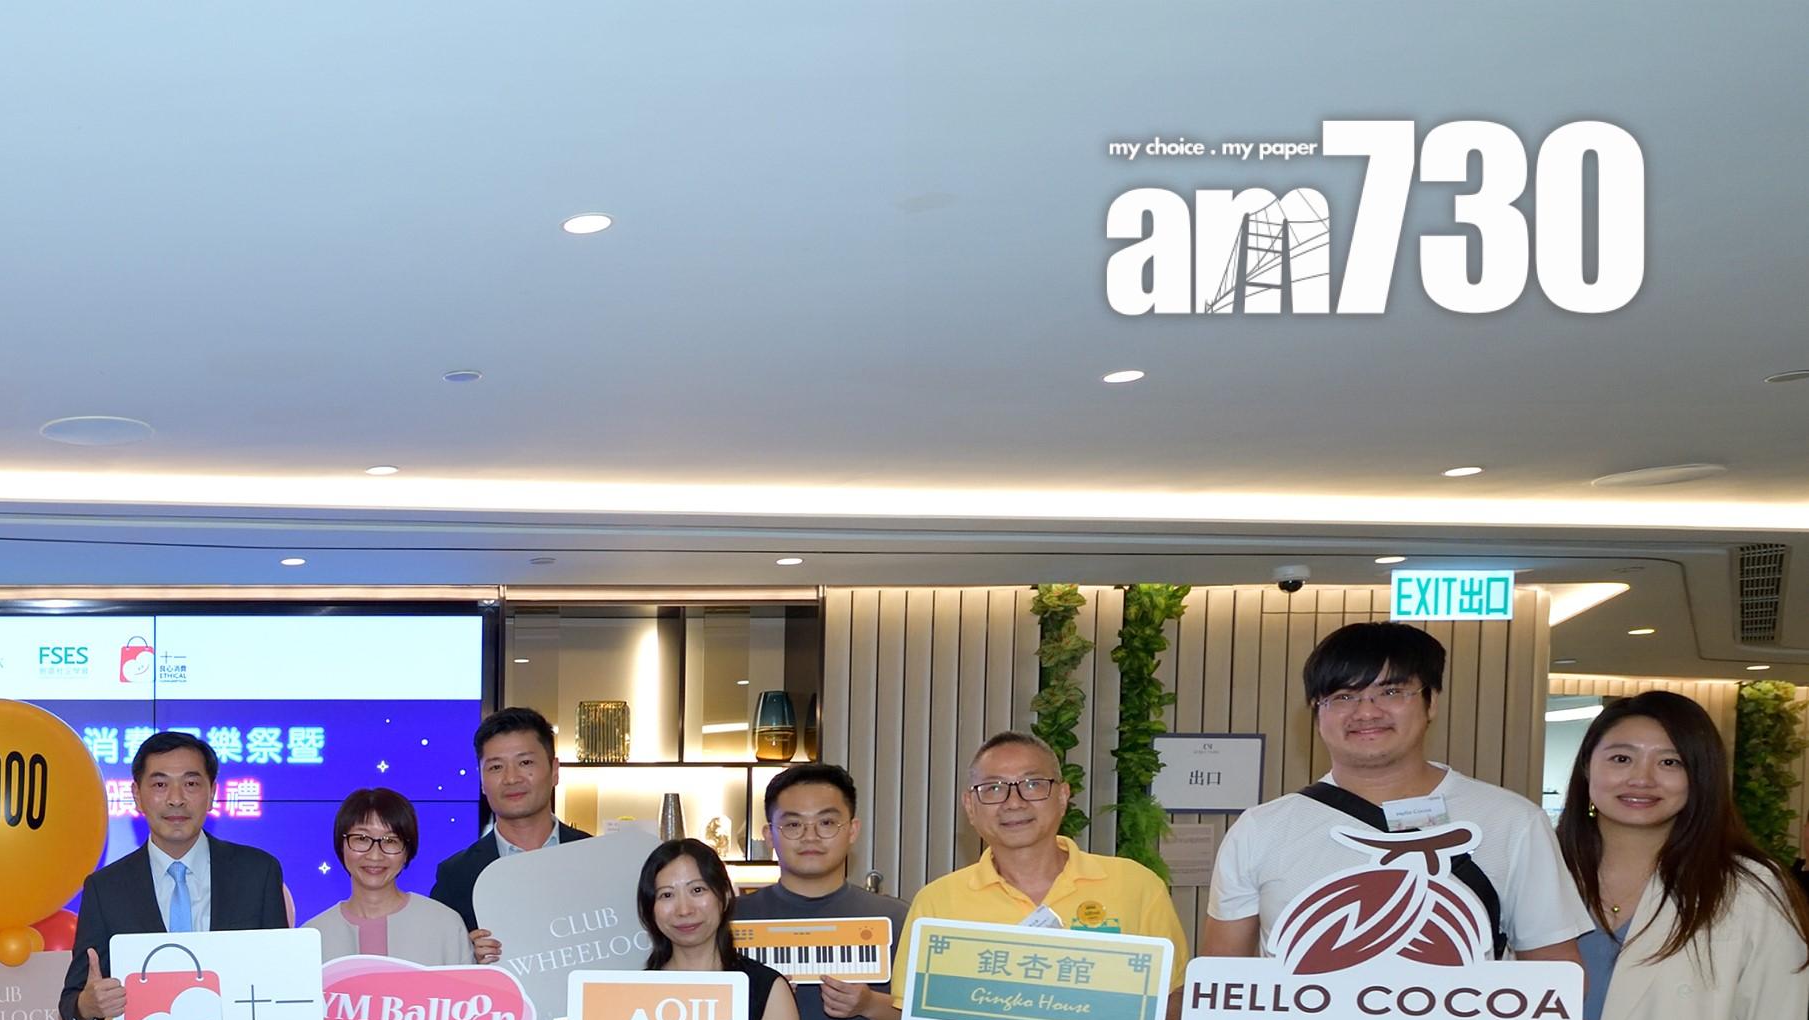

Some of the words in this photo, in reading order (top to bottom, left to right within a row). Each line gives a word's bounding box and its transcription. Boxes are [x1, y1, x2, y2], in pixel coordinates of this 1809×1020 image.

[1396, 577, 1457, 616] EXIT
[1459, 577, 1510, 616] 出口
[39, 646, 89, 665] FSES
[159, 650, 187, 664] 十一
[1189, 769, 1221, 786] 出口
[550, 907, 619, 939] CLUB
[508, 930, 655, 977] WHEELOC
[977, 949, 1096, 985] 銀杏館
[970, 987, 1034, 1012] Gingko
[1038, 993, 1091, 1013] House
[1191, 981, 1332, 1014] HELLO
[1356, 984, 1571, 1020] COCOA
